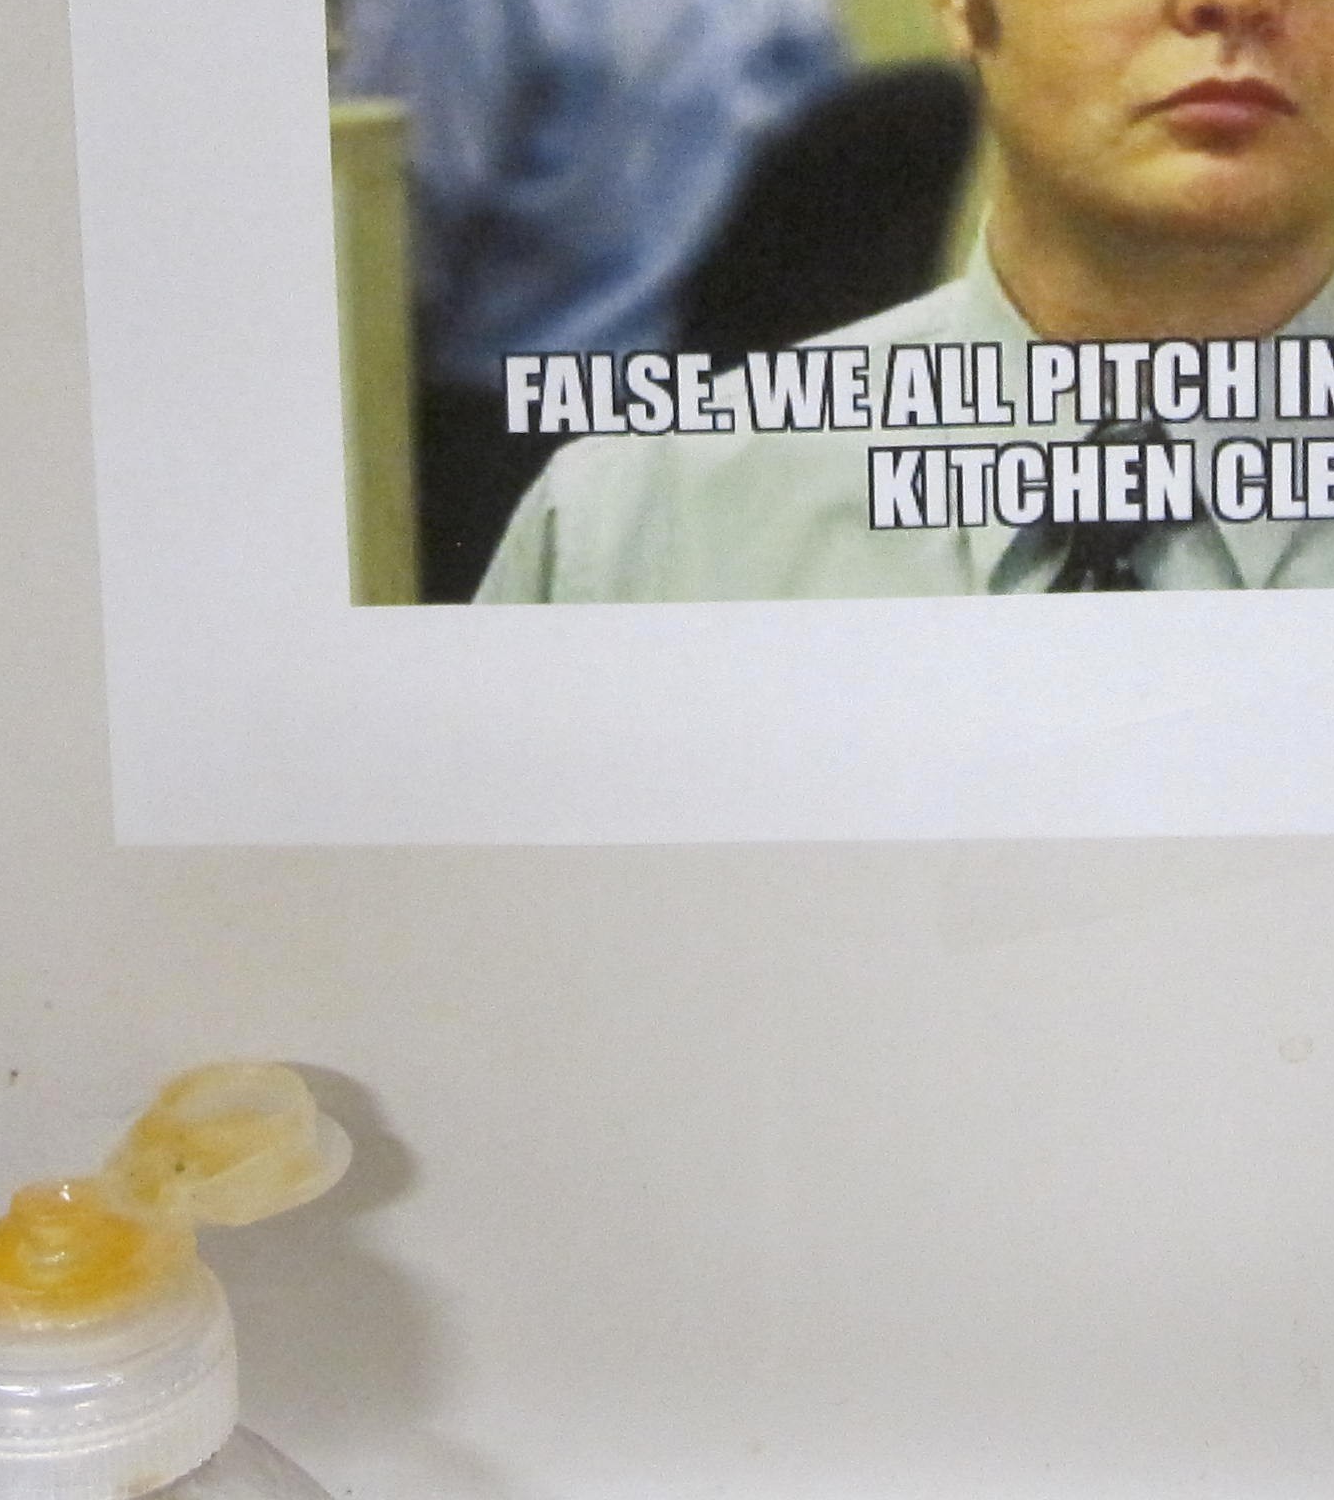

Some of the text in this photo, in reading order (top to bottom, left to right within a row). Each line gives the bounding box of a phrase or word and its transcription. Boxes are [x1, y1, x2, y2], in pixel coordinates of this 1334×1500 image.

[501, 345, 735, 436] FALSE.
[743, 344, 870, 431] WE
[880, 342, 1014, 429] ALL
[1027, 336, 1259, 425] PITCH
[867, 440, 1198, 531] KITCHEN
